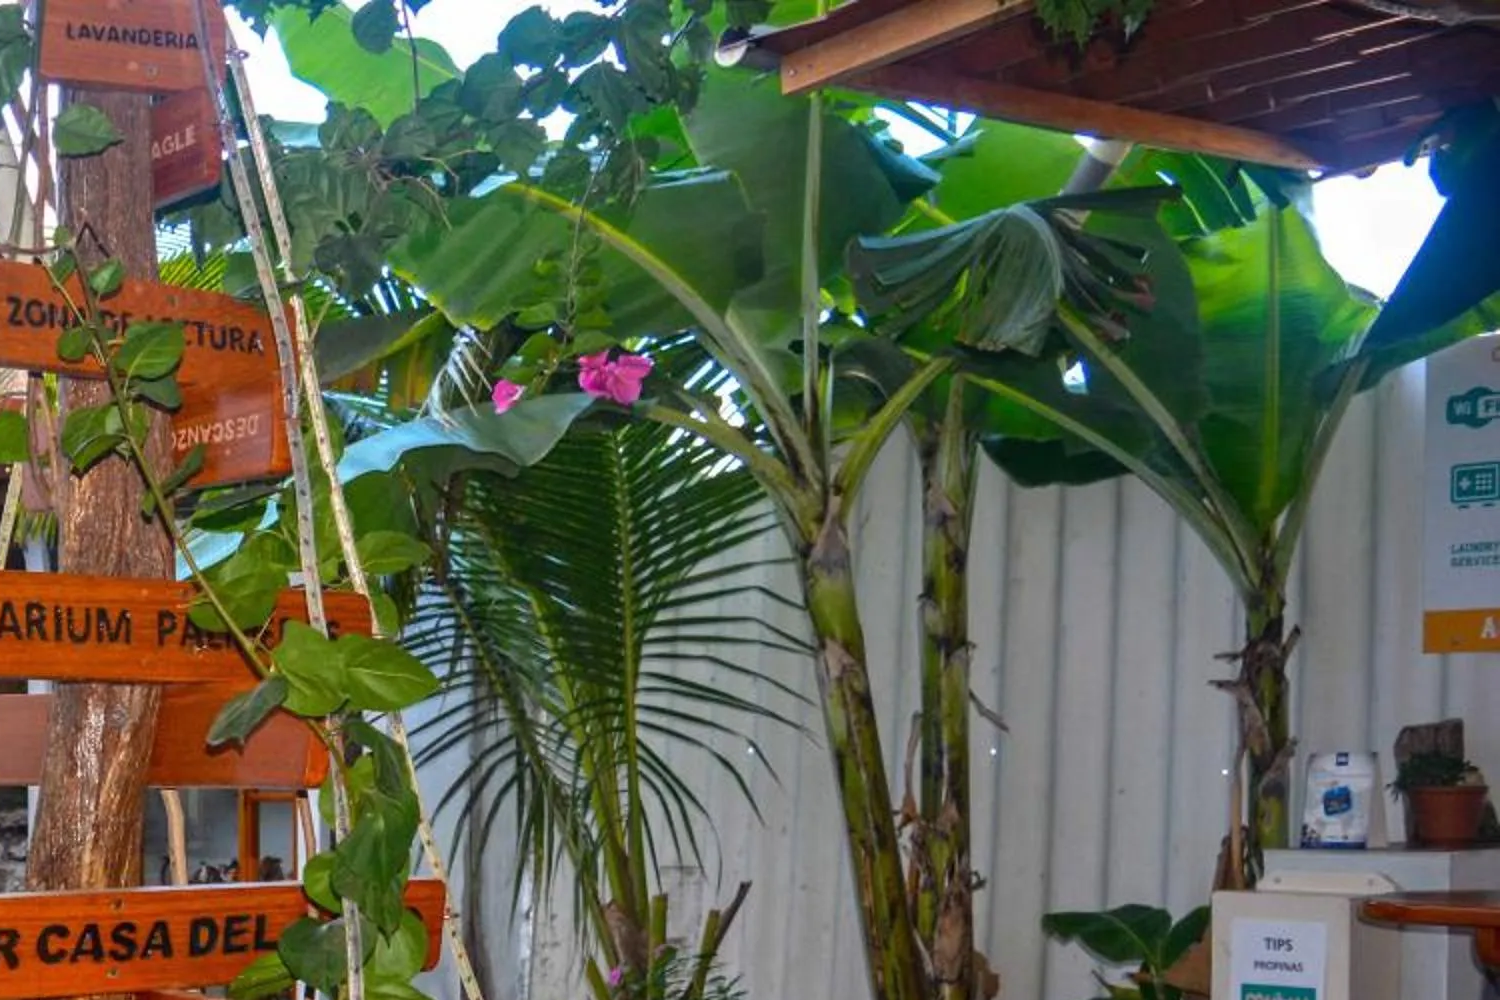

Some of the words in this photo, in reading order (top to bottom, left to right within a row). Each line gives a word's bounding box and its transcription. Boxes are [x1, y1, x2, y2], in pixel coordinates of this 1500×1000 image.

[66, 21, 199, 49] LAVANDERIA
[151, 124, 197, 160] AGLE
[146, 314, 265, 356] TURA
[172, 414, 260, 451] DESCANZ
[35, 915, 173, 971] CASA
[187, 912, 278, 956] DEL
[1263, 936, 1294, 953] TIPS
